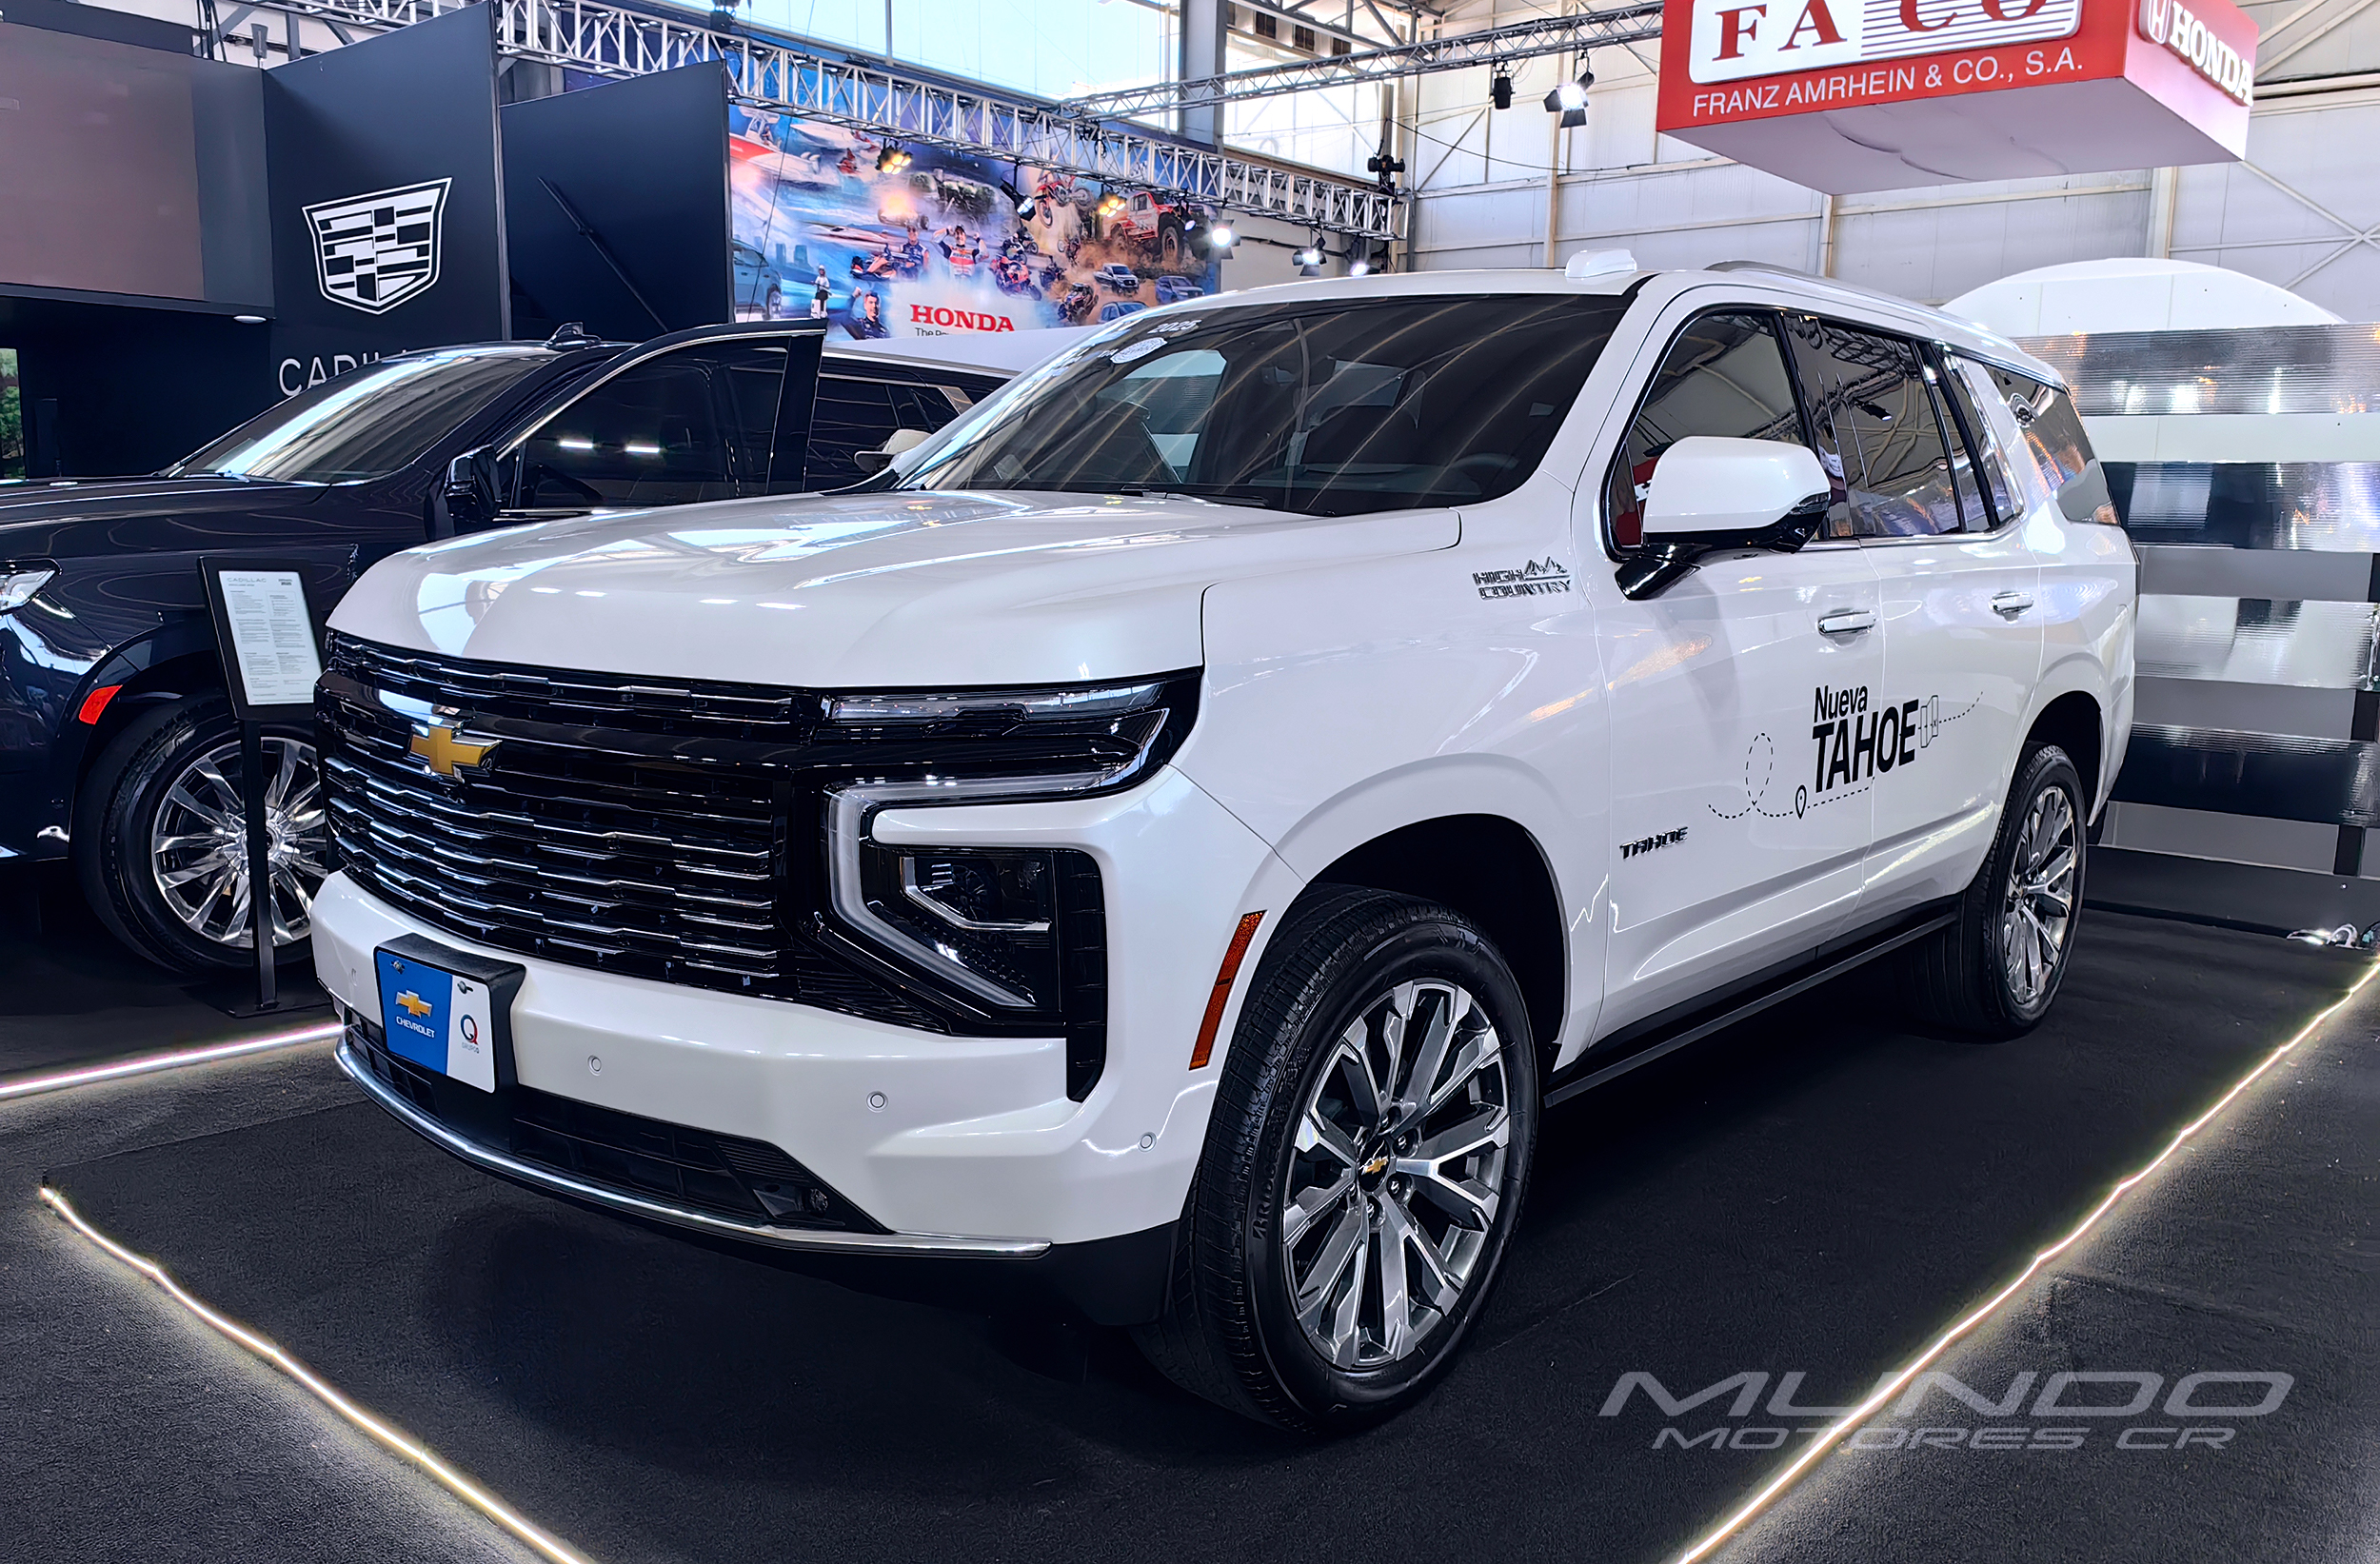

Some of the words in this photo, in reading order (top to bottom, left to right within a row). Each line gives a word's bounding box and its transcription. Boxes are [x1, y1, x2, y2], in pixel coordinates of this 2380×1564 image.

[2170, 1, 2253, 107] HONDA
[1693, 85, 1780, 117] FRANZ
[1785, 68, 1914, 106] AMRHEIN
[1924, 64, 1943, 89] &
[1953, 55, 2014, 85] CO.,
[2025, 47, 2084, 76] S.A.
[910, 304, 1015, 332] HONDA
[1472, 569, 1524, 585] HIGH
[1478, 580, 1571, 600] COUNTRY
[1814, 684, 1868, 723] Nueva
[1812, 698, 1919, 793] TAHOE
[1619, 826, 1689, 859] TAHOE
[395, 1015, 435, 1039] CHEVROLET
